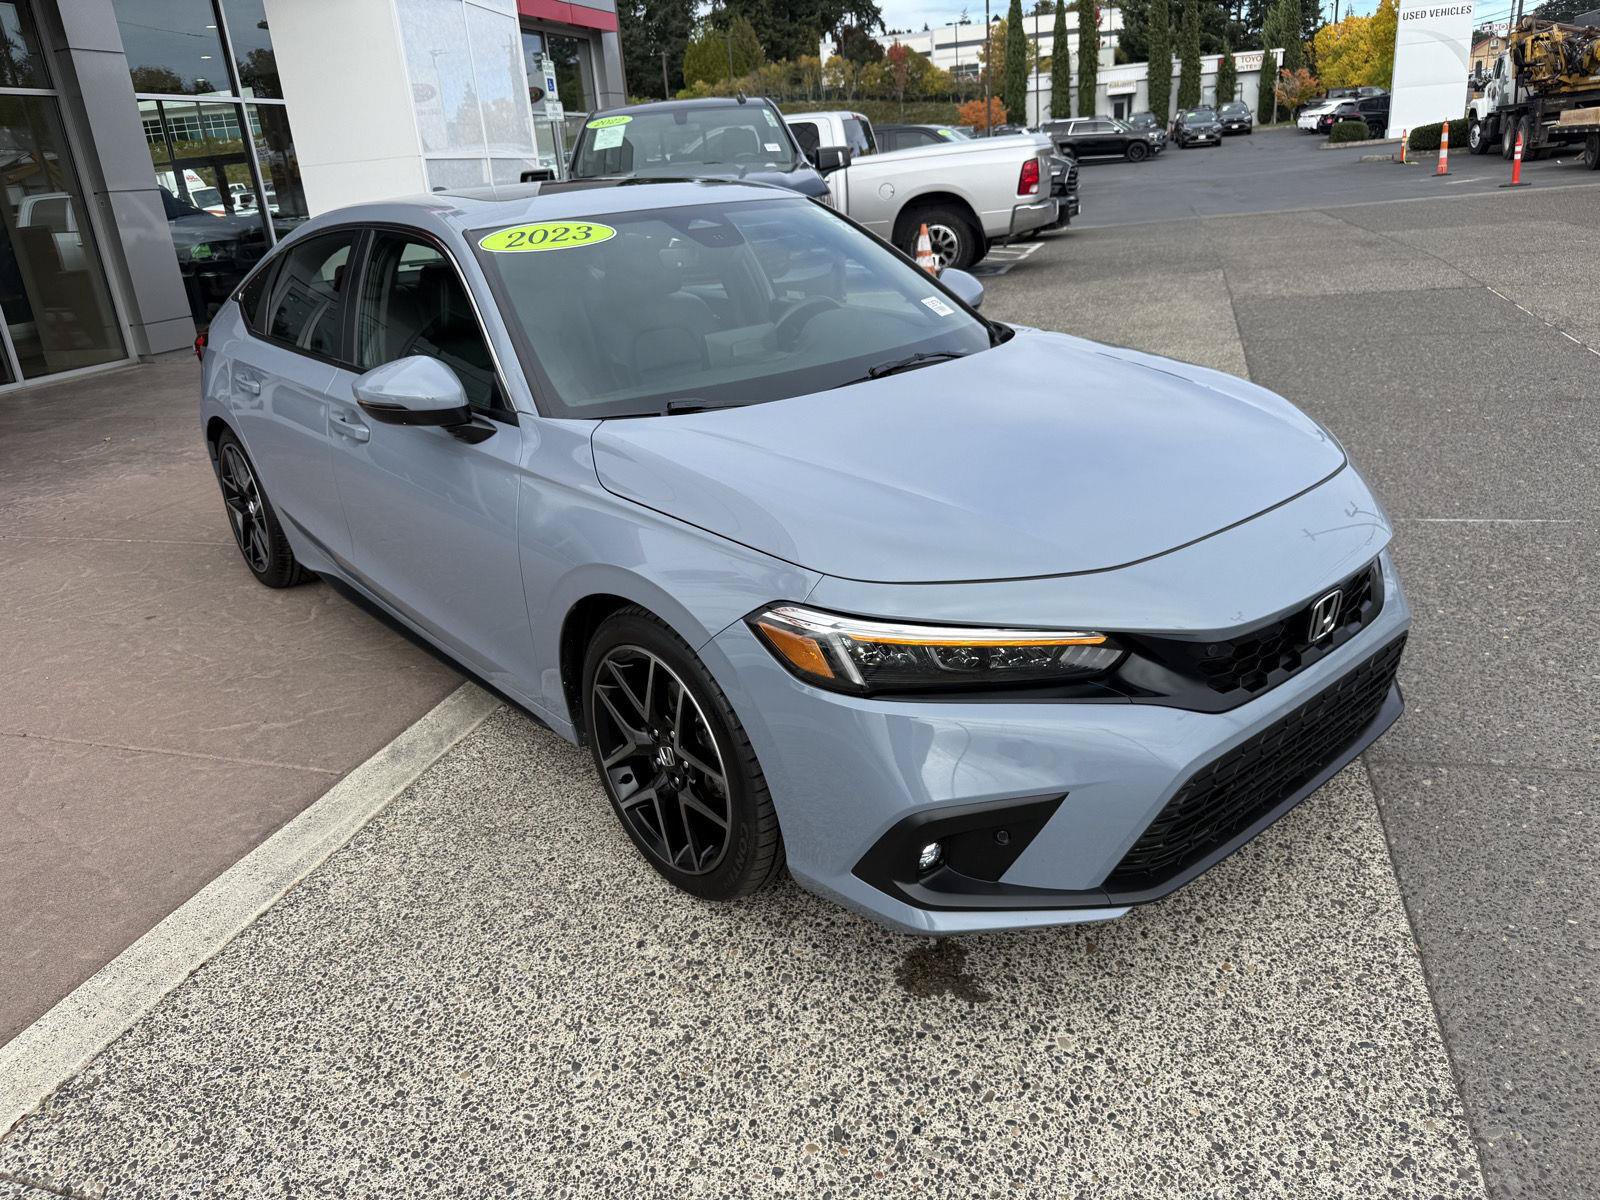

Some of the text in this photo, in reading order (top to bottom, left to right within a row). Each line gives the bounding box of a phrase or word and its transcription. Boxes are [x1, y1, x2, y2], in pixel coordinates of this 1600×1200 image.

[1402, 5, 1473, 21] USED VEHICLES
[1241, 55, 1264, 63] TOYO
[504, 225, 593, 249] 2023
